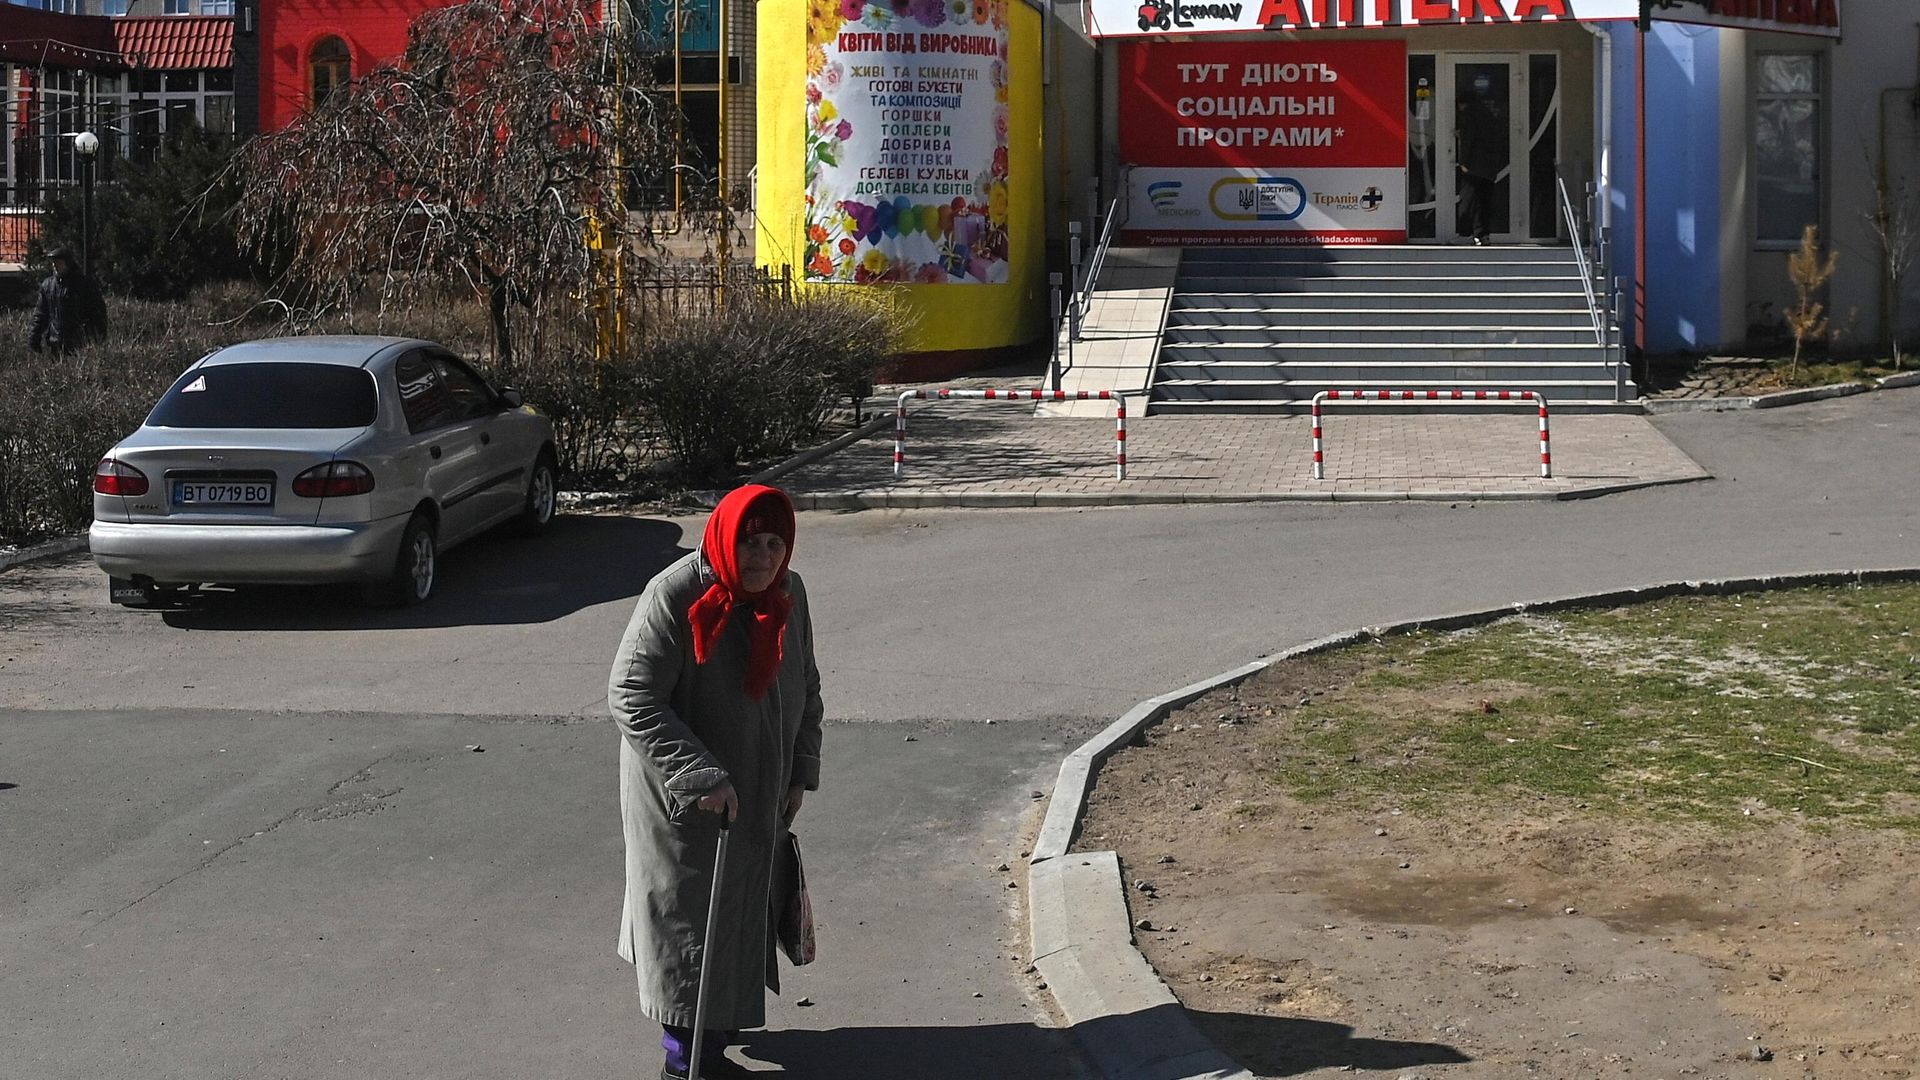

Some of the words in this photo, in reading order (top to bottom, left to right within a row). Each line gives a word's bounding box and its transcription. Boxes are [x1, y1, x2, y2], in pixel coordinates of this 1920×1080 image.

[838, 32, 883, 53] КВІТИ
[886, 32, 917, 54] ВІД
[920, 33, 998, 56] ВИРОБНИКА
[851, 65, 885, 78] ЖИВІ
[893, 66, 911, 78] ТА
[918, 67, 979, 80] КІМНАТНІ
[1177, 63, 1229, 83] ТУТ
[1241, 63, 1338, 87] ДІЮТЬ
[869, 80, 913, 93] ГОТОВІ
[918, 81, 963, 94] БУКЕТИ
[871, 94, 887, 107] ТА
[889, 94, 962, 110] КОМПОЗИЦІЇ
[1177, 96, 1336, 120] СОЦІАЛЬНІ
[882, 109, 942, 122] ГОРШКИ
[881, 124, 951, 137] ТОПЛЕРИ
[880, 138, 951, 152] ДОБРИВА
[878, 153, 953, 166] ЛИСТІВКИ
[860, 167, 909, 180] ГЕЛЕВІ
[917, 168, 969, 181] КУЛЬКИ
[855, 182, 929, 196] ДОСТАВКА
[933, 183, 973, 195] КВІТІВ
[1264, 235, 1378, 245] apteka-ot-sklada.com.ua
[183, 486, 205, 501] BT
[208, 486, 242, 501] 0719
[245, 486, 268, 501] BO
